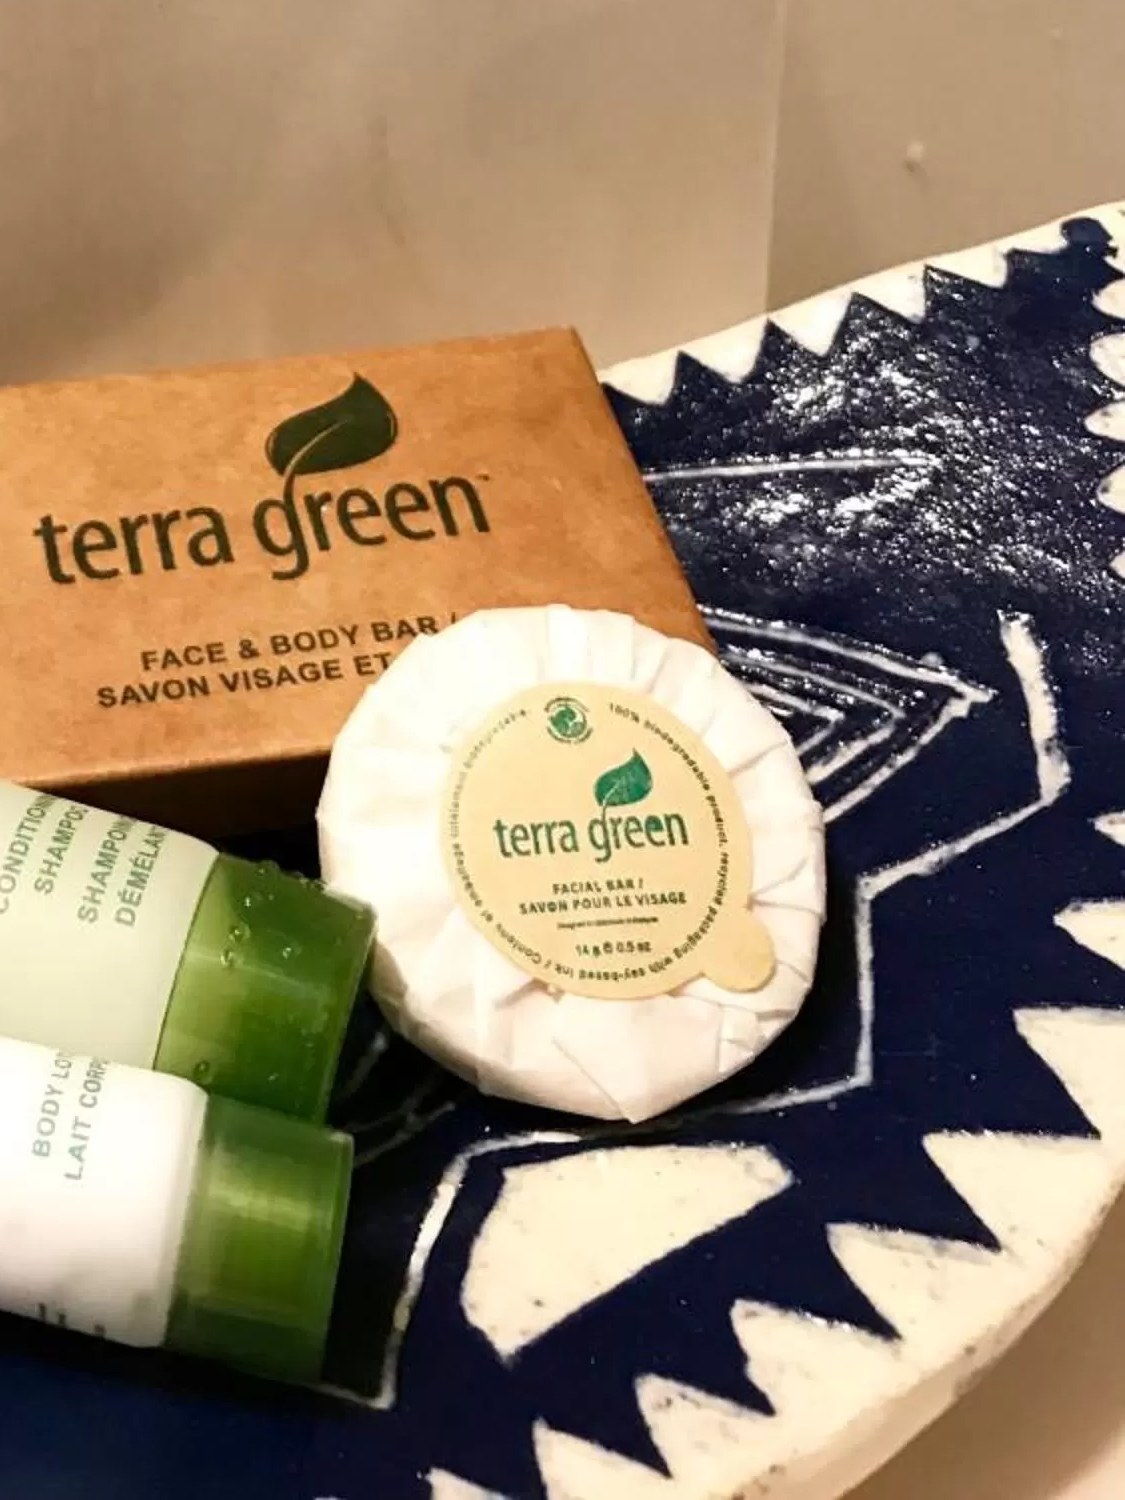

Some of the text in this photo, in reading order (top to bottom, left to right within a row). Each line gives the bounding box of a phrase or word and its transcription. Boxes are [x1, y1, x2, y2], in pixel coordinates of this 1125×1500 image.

[34, 474, 491, 585] terra green
[141, 642, 227, 672] FACE
[237, 640, 261, 660] &
[271, 624, 360, 657] BODY
[372, 616, 439, 642] BAR
[97, 652, 391, 709] SAVON VISAGE ET
[493, 808, 689, 864] terra green
[519, 892, 687, 915] SAVON POUR LE VISAGE
[552, 882, 602, 895] FACIAL
[606, 879, 635, 891] BAR
[31, 1083, 63, 1158] BODY
[63, 1116, 91, 1181] LAIT
